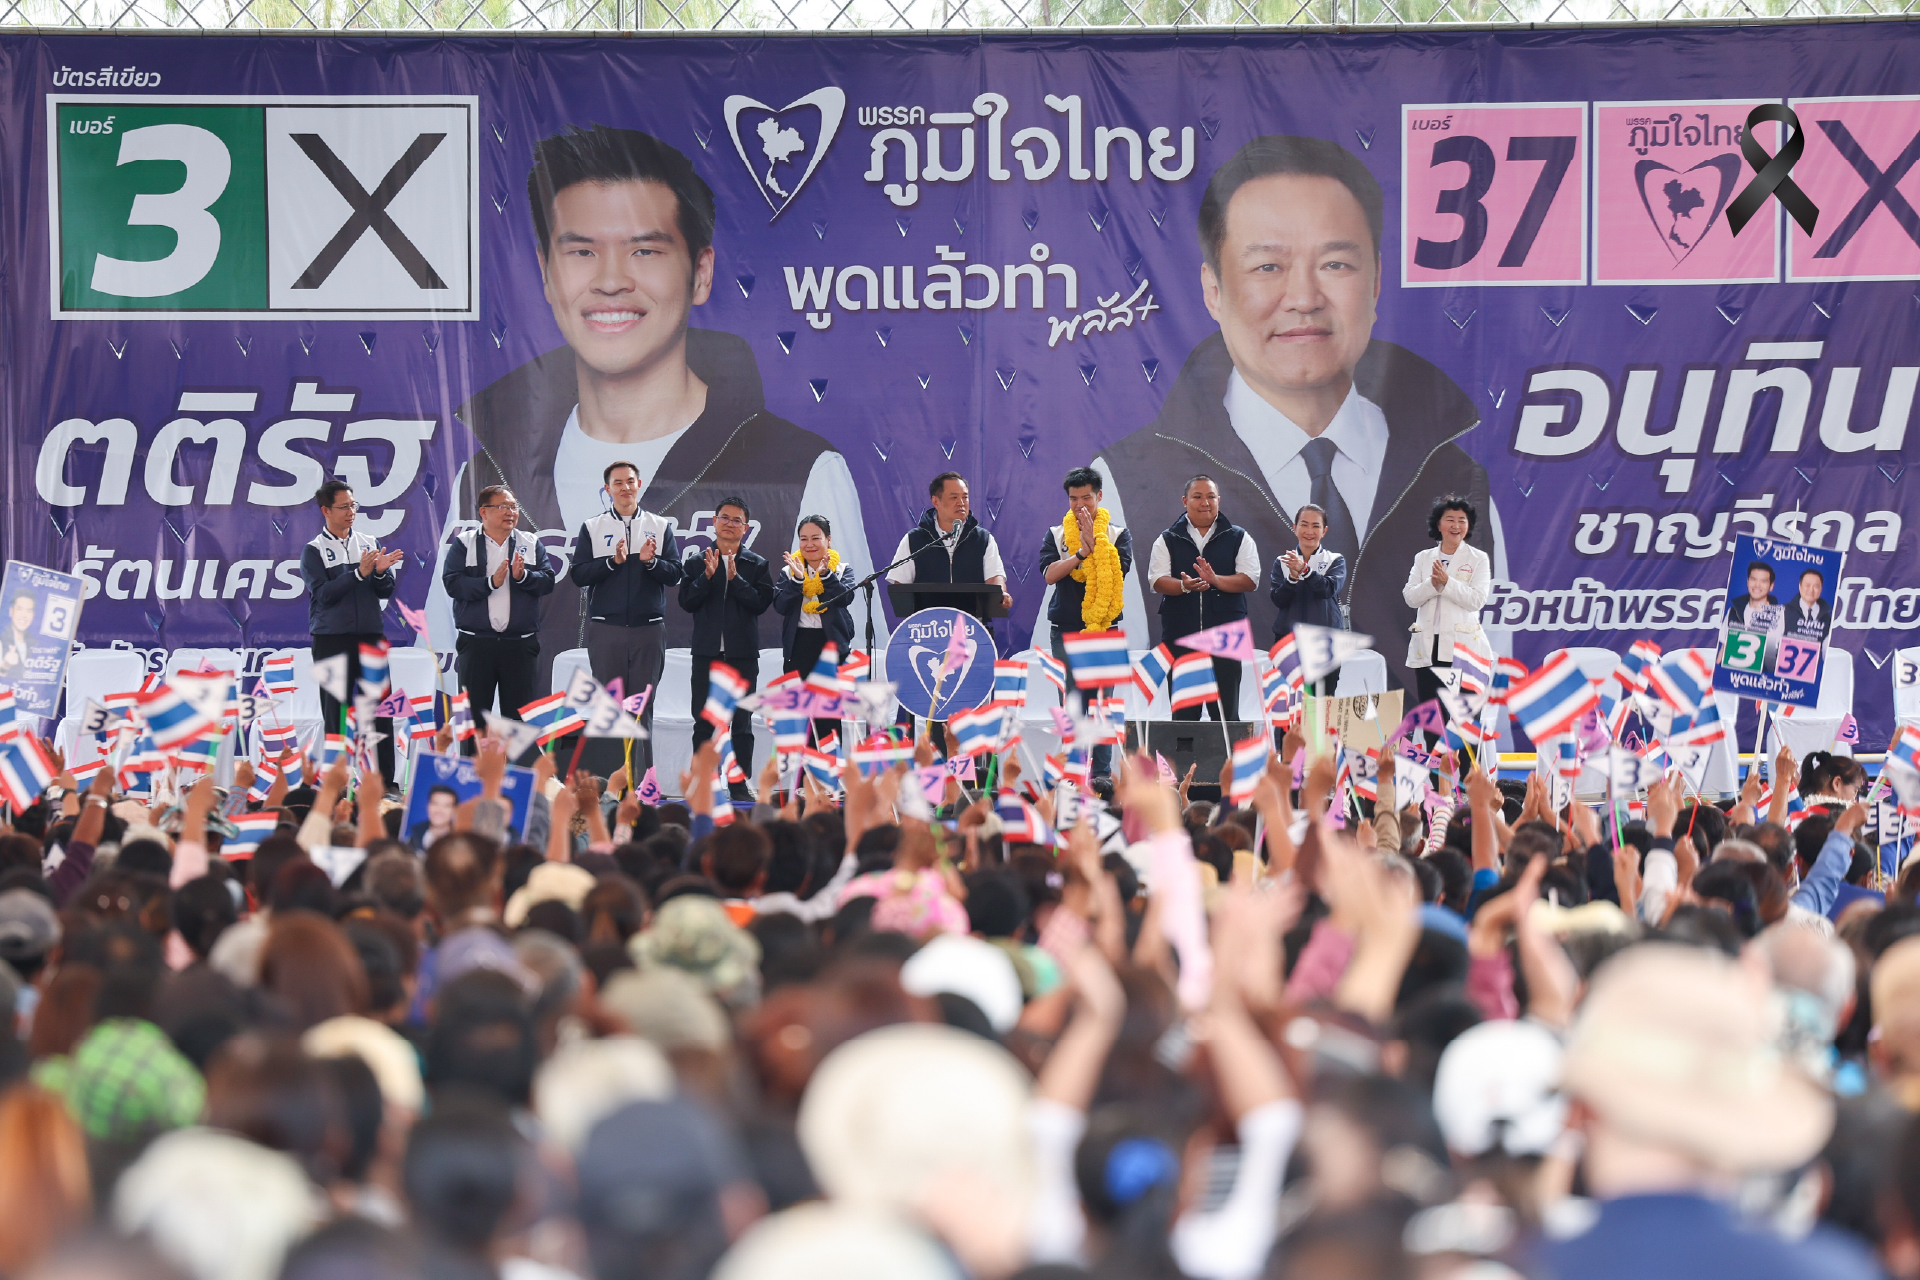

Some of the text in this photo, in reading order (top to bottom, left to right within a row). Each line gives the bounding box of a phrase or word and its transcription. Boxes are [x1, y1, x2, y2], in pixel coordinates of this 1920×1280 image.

[52, 65, 162, 88] บัตรสีเขียว
[69, 115, 116, 135] เบอร์
[858, 105, 925, 126] พรรค
[1411, 115, 1453, 131] เบอร์
[1626, 117, 1652, 126] พรรค
[864, 92, 1195, 206] ภูมิใจไทย
[90, 123, 232, 298] 3
[1413, 135, 1577, 271] 37
[784, 243, 1077, 329] พูดแล้วทำ
[1513, 341, 1920, 493] อนุทิน
[35, 382, 437, 539] ตติรัฐ
[1574, 493, 1902, 562] ชาญวีรกล
[603, 534, 614, 547] 7
[325, 547, 336, 562] 9
[71, 544, 403, 611] รัตนเศร
[50, 606, 67, 633] 3
[909, 620, 975, 643] ภูมิใจไย
[1213, 630, 1246, 650] 37
[1314, 635, 1335, 668] 3
[1727, 633, 1761, 668] 3
[1777, 644, 1817, 677] 37
[1446, 672, 1456, 686] 3
[1730, 671, 1791, 693] พูดแล้วทำ
[1900, 662, 1918, 684] 3
[573, 680, 596, 703] 3
[784, 689, 816, 710] 37
[241, 697, 256, 719] 3
[383, 696, 405, 716] 37
[87, 709, 108, 731] 3
[595, 706, 620, 732] 3
[779, 754, 789, 772] 3
[1355, 755, 1367, 778] 3
[1407, 749, 1430, 765] 37
[1682, 752, 1700, 768] 3
[1618, 757, 1641, 789] 3
[1884, 812, 1907, 837] 3
